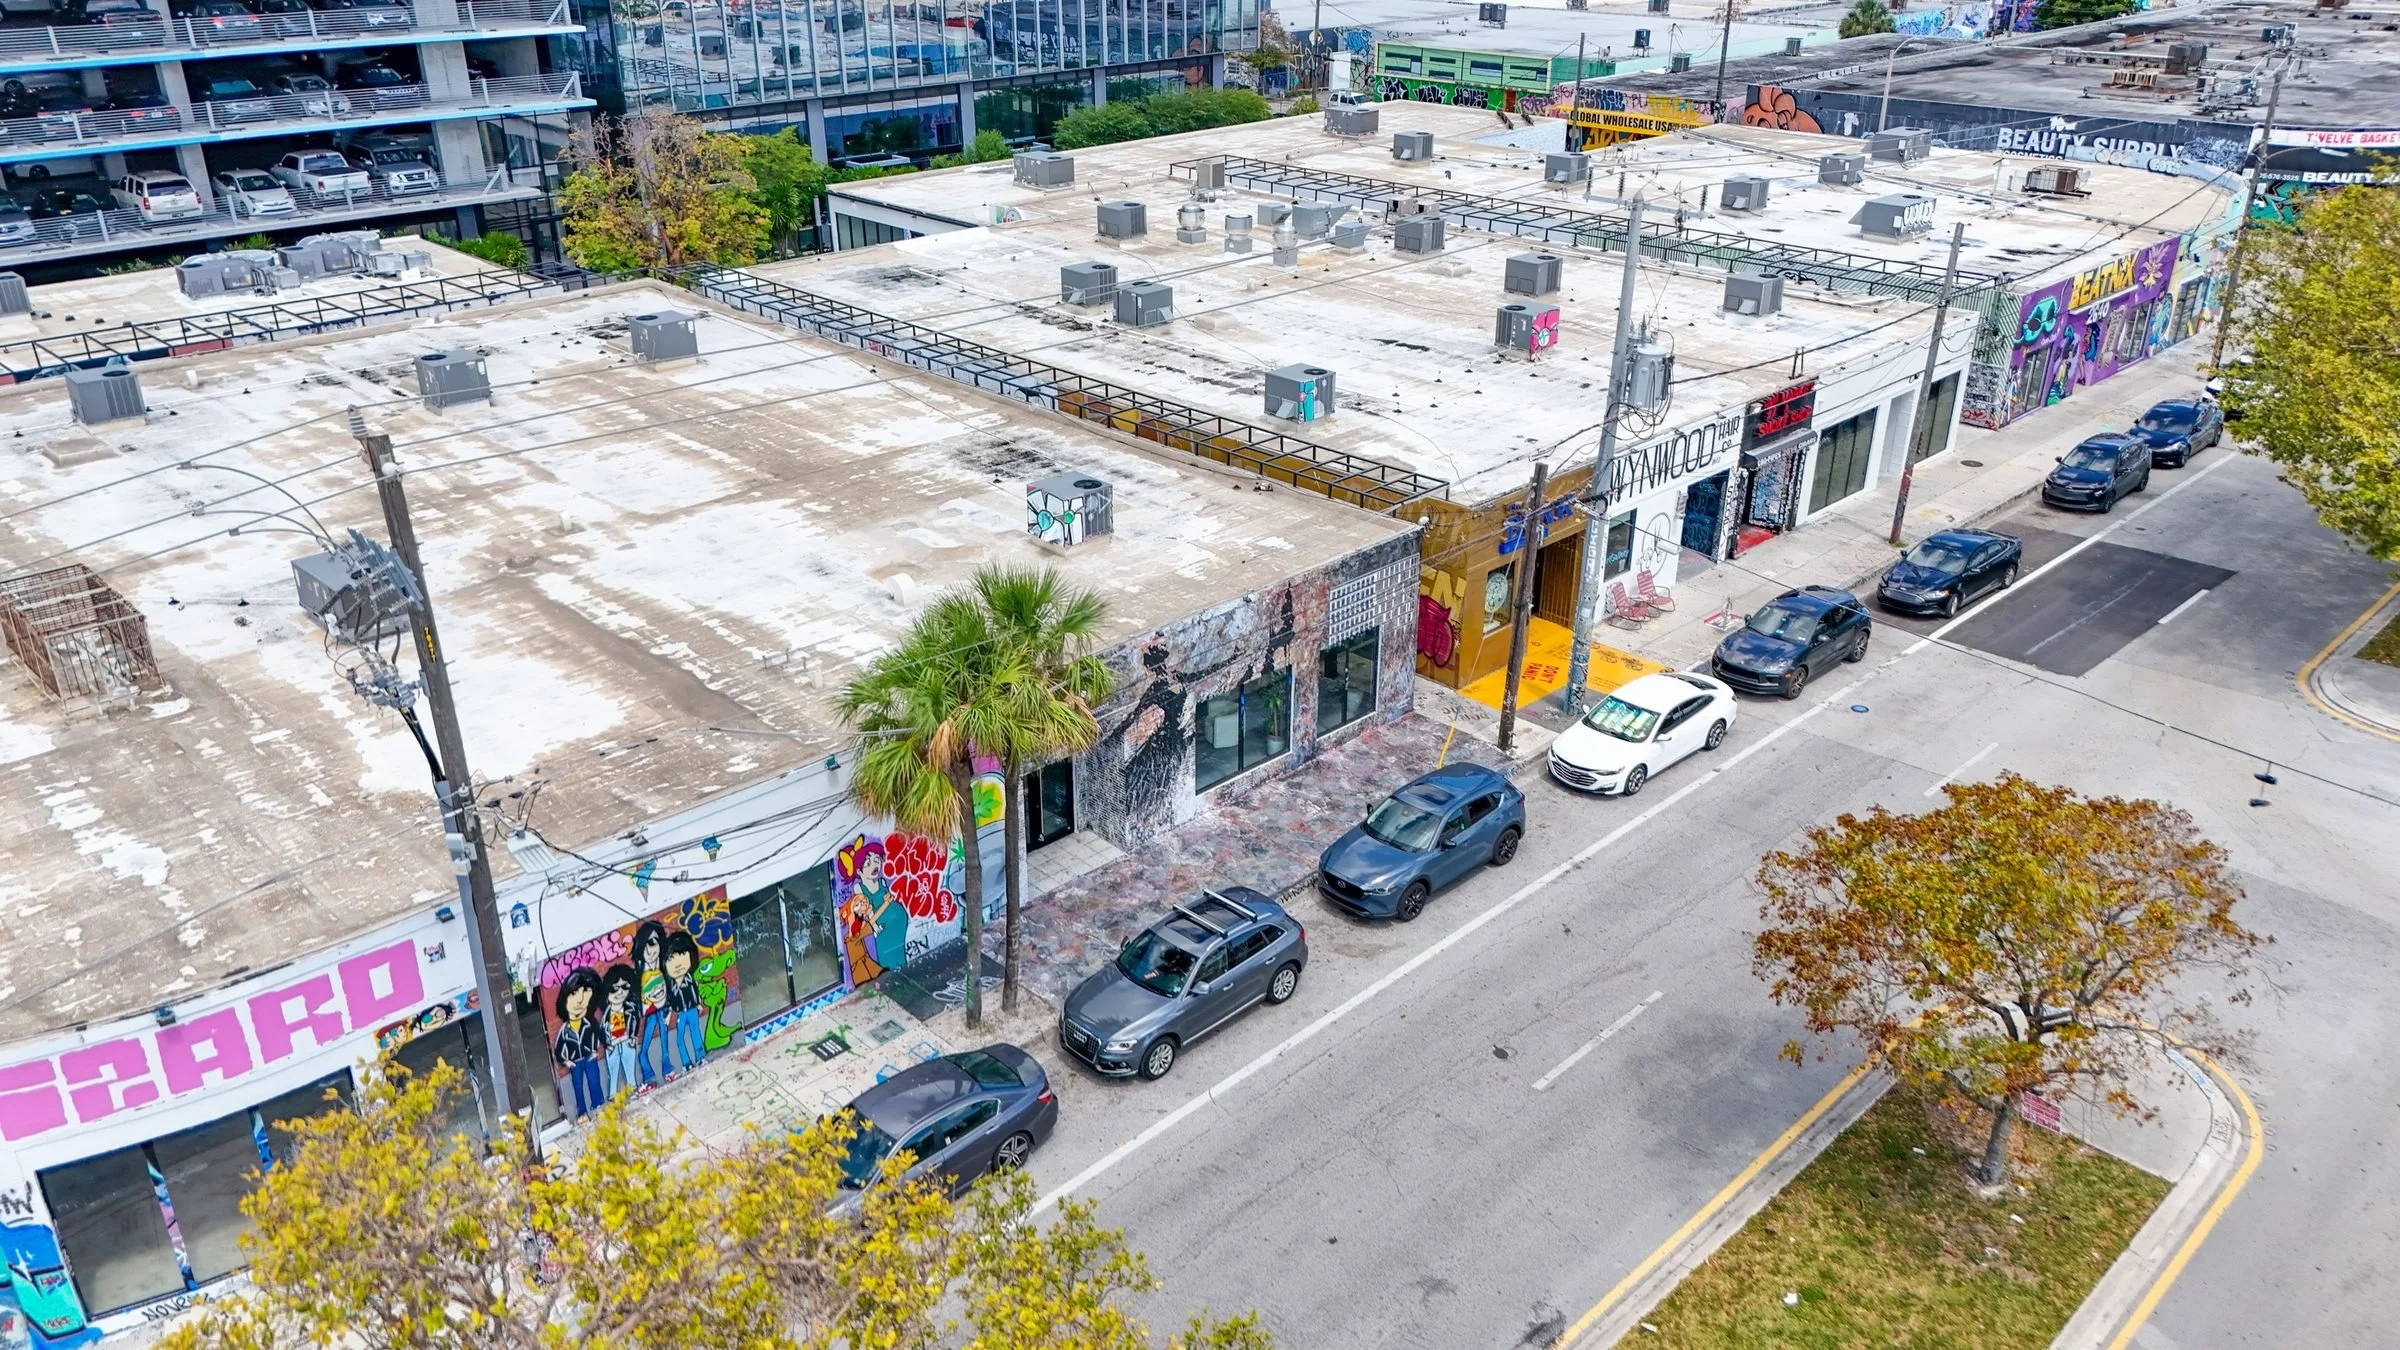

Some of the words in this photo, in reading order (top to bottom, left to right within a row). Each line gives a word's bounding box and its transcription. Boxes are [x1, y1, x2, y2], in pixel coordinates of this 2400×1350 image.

[1603, 114, 1653, 130] WHOLESALE
[1655, 120, 1673, 132] USA
[1997, 127, 2087, 154] BEAUTY
[2093, 137, 2185, 159] SUPPLY
[2302, 171, 2375, 183] BEAUTY
[1718, 415, 1741, 441] HAIR
[1609, 423, 1716, 506] WYNWOOD
